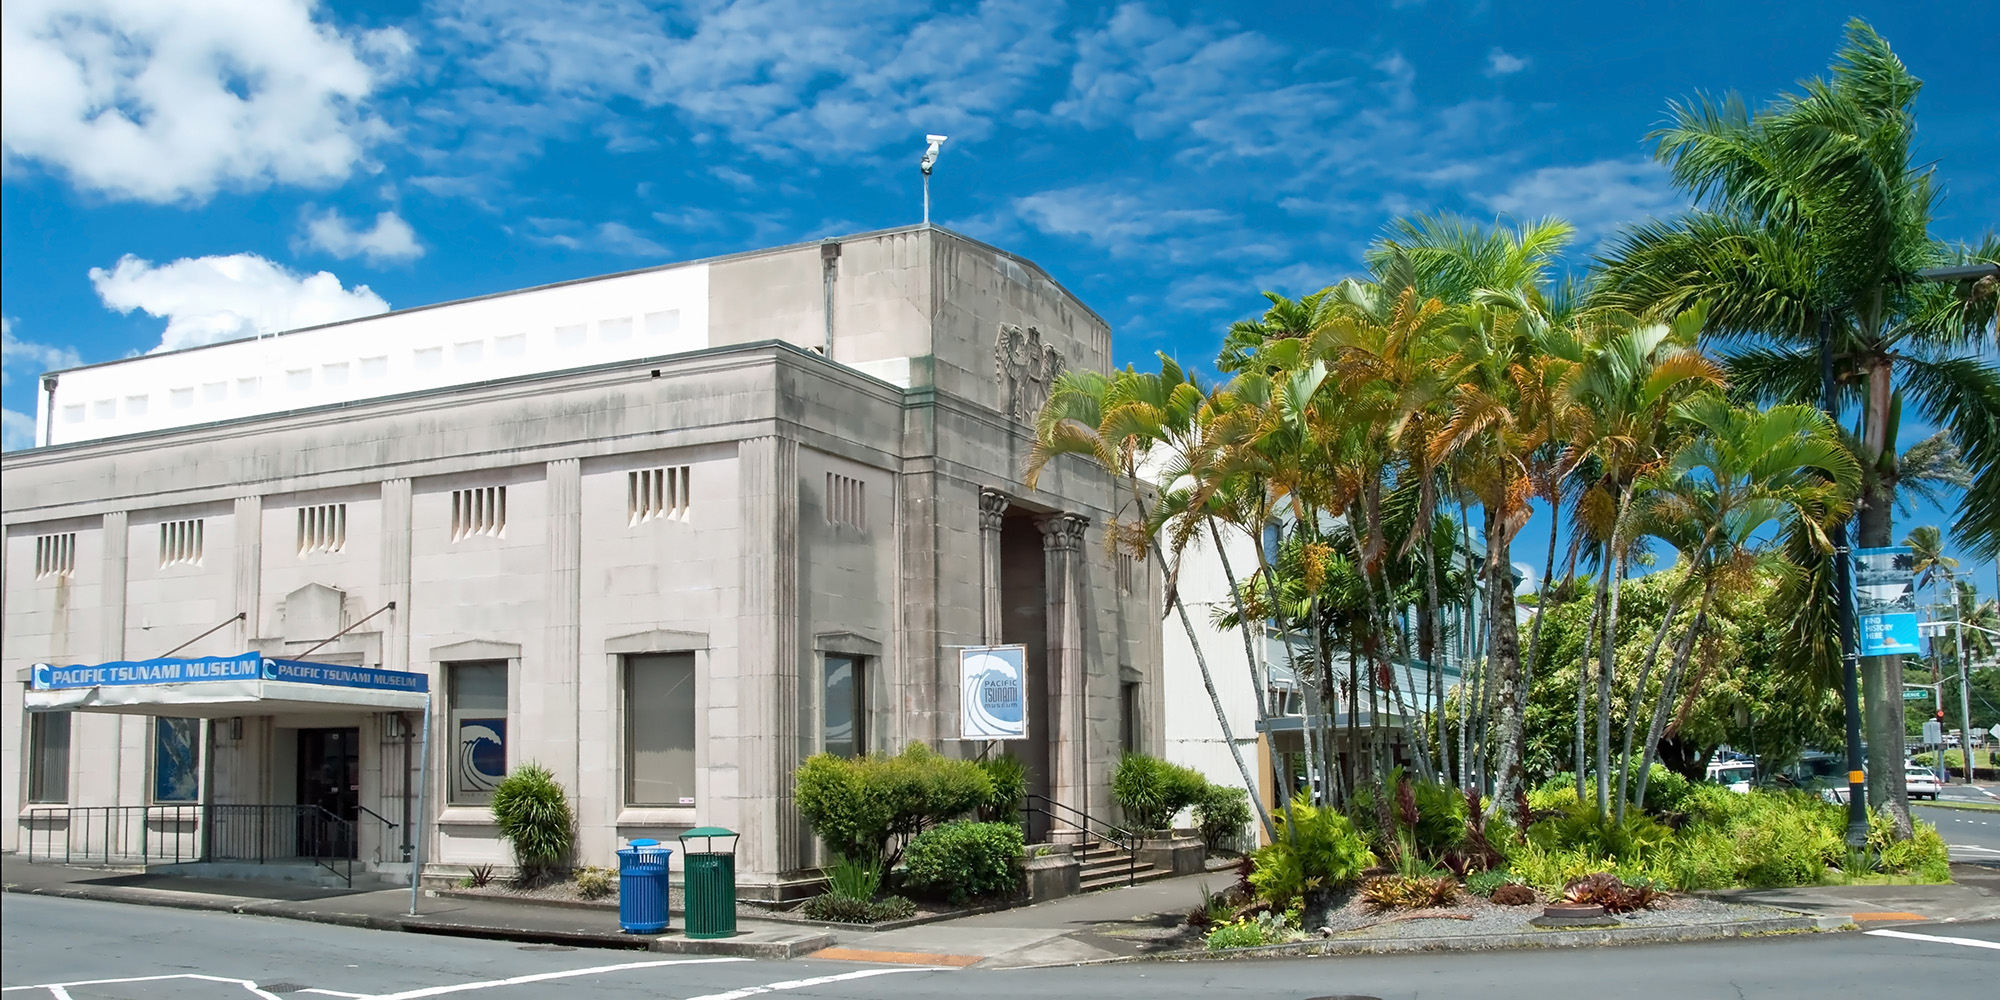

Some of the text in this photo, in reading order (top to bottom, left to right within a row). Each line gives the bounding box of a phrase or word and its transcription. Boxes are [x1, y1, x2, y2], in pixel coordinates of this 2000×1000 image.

[1865, 624, 1894, 632] HISTORY
[52, 660, 256, 684] PACIFIC TSUNAMI MUSEUM
[278, 665, 416, 687] PACIFIC TSUNAMI MUSEUM
